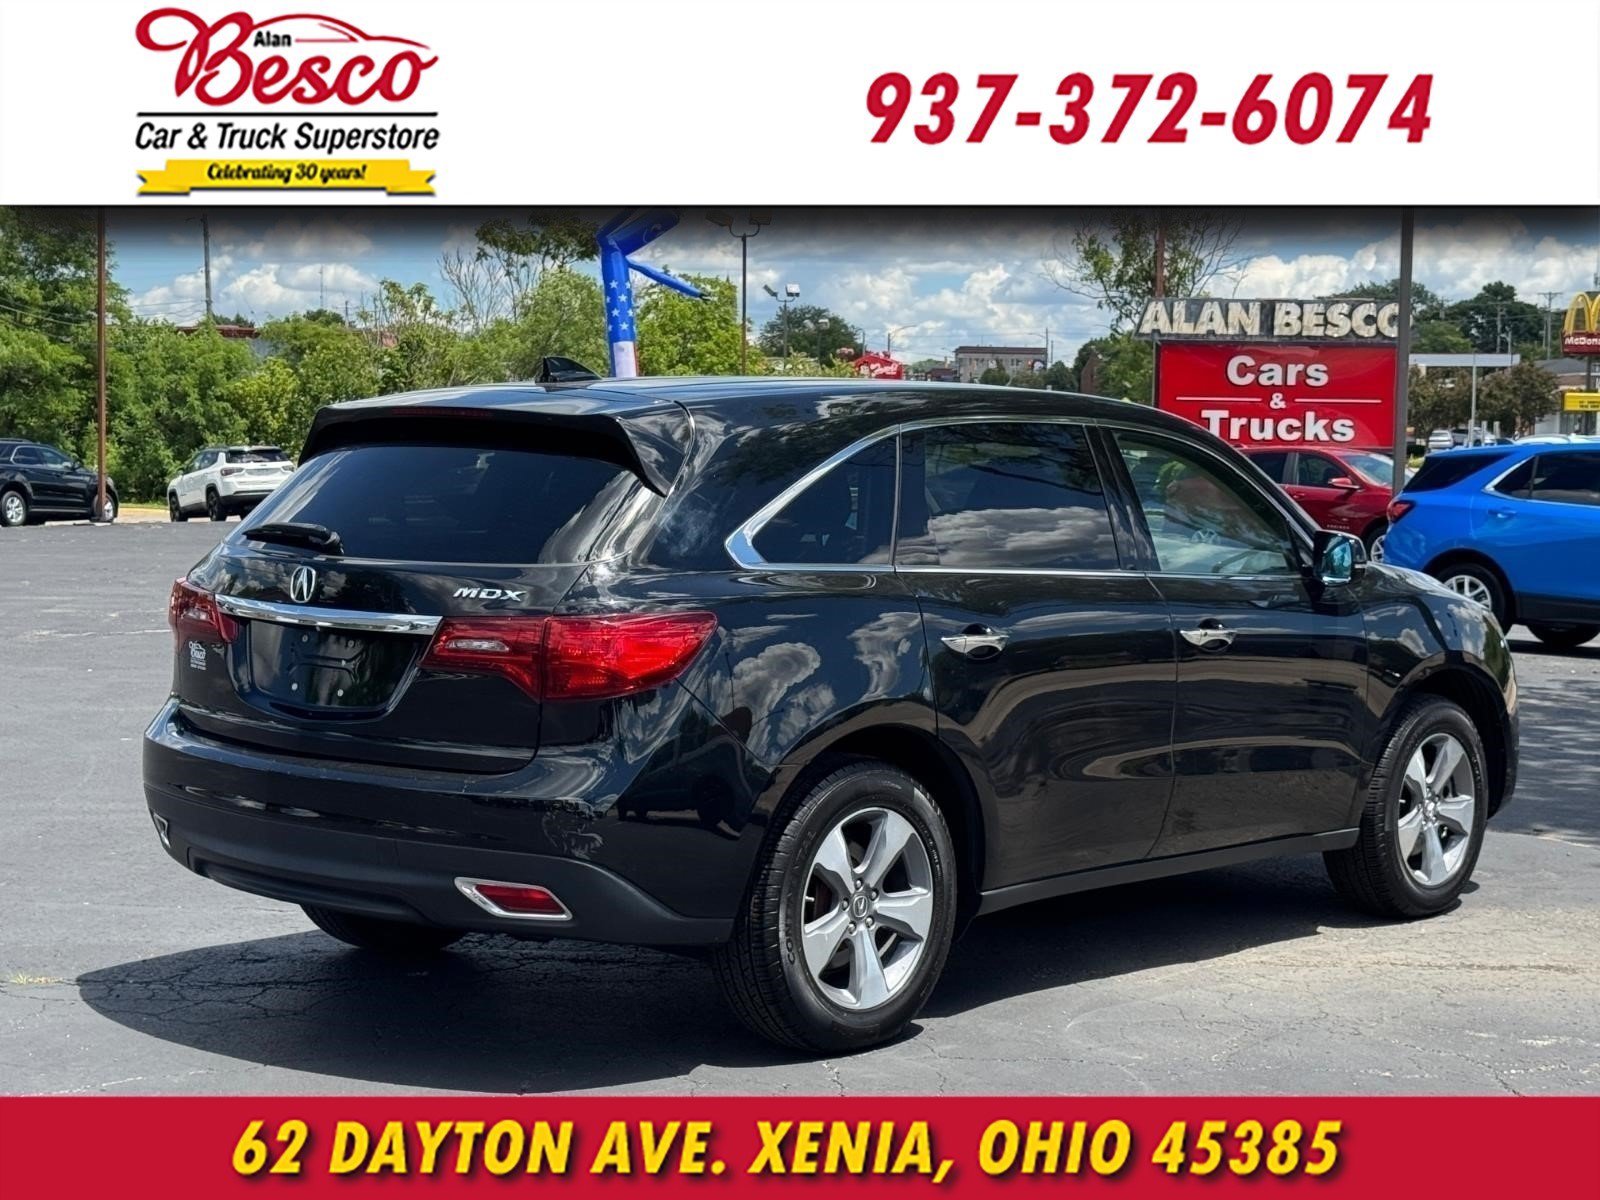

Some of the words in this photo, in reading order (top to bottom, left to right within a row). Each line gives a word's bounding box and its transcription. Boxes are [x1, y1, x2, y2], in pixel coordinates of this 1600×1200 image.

[1139, 301, 1261, 335] ALAN
[1565, 336, 1600, 345] McDon
[1227, 355, 1329, 387] Cars
[1269, 392, 1287, 409] &
[1201, 409, 1355, 441] Trucks
[453, 587, 527, 601] MDX
